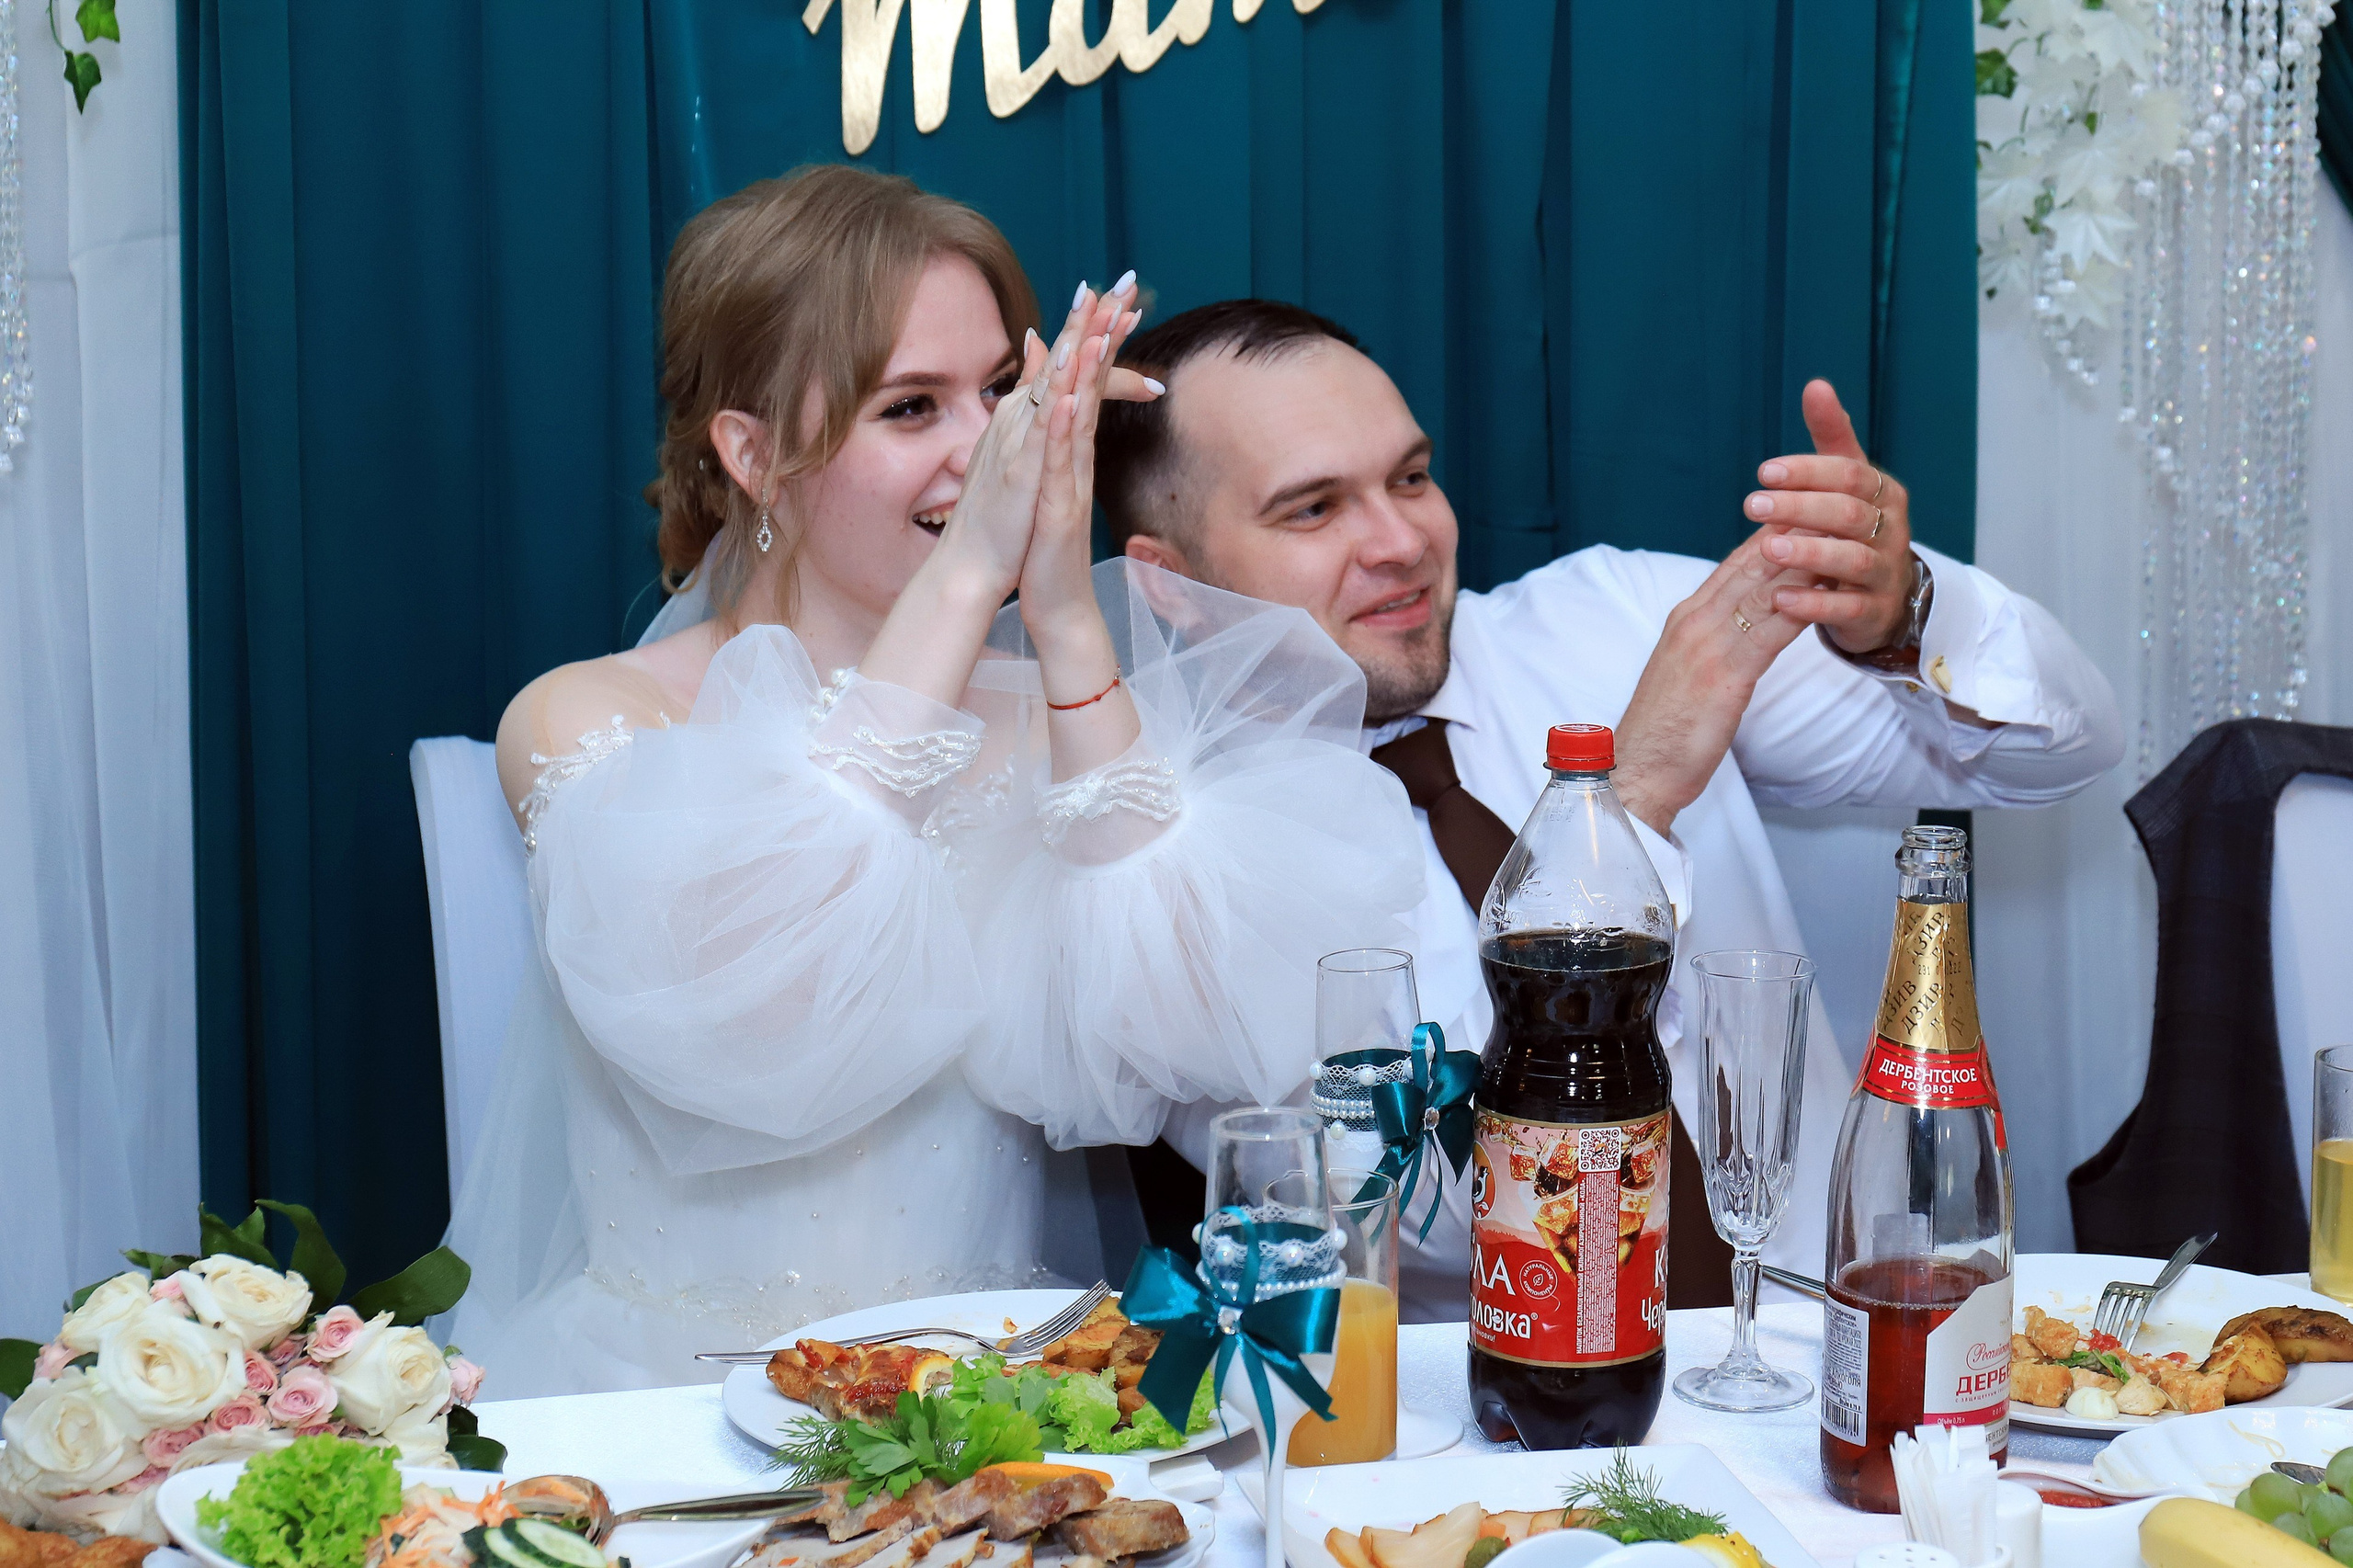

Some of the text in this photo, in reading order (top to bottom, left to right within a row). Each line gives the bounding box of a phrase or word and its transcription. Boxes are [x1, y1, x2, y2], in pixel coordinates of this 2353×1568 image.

[1900, 982, 1944, 1036] ДЗИВ
[1878, 1058, 1978, 1084] ДЕРБЕНТСКОЕ
[1901, 1080, 1954, 1094] РОЗОВОЕ
[1470, 1241, 1517, 1296] ЛА
[1523, 1263, 1554, 1280] НАТУРАЛЬНЫЕ
[1654, 1244, 1668, 1289] К
[1523, 1280, 1553, 1296] КОМПОНЕНТЫ
